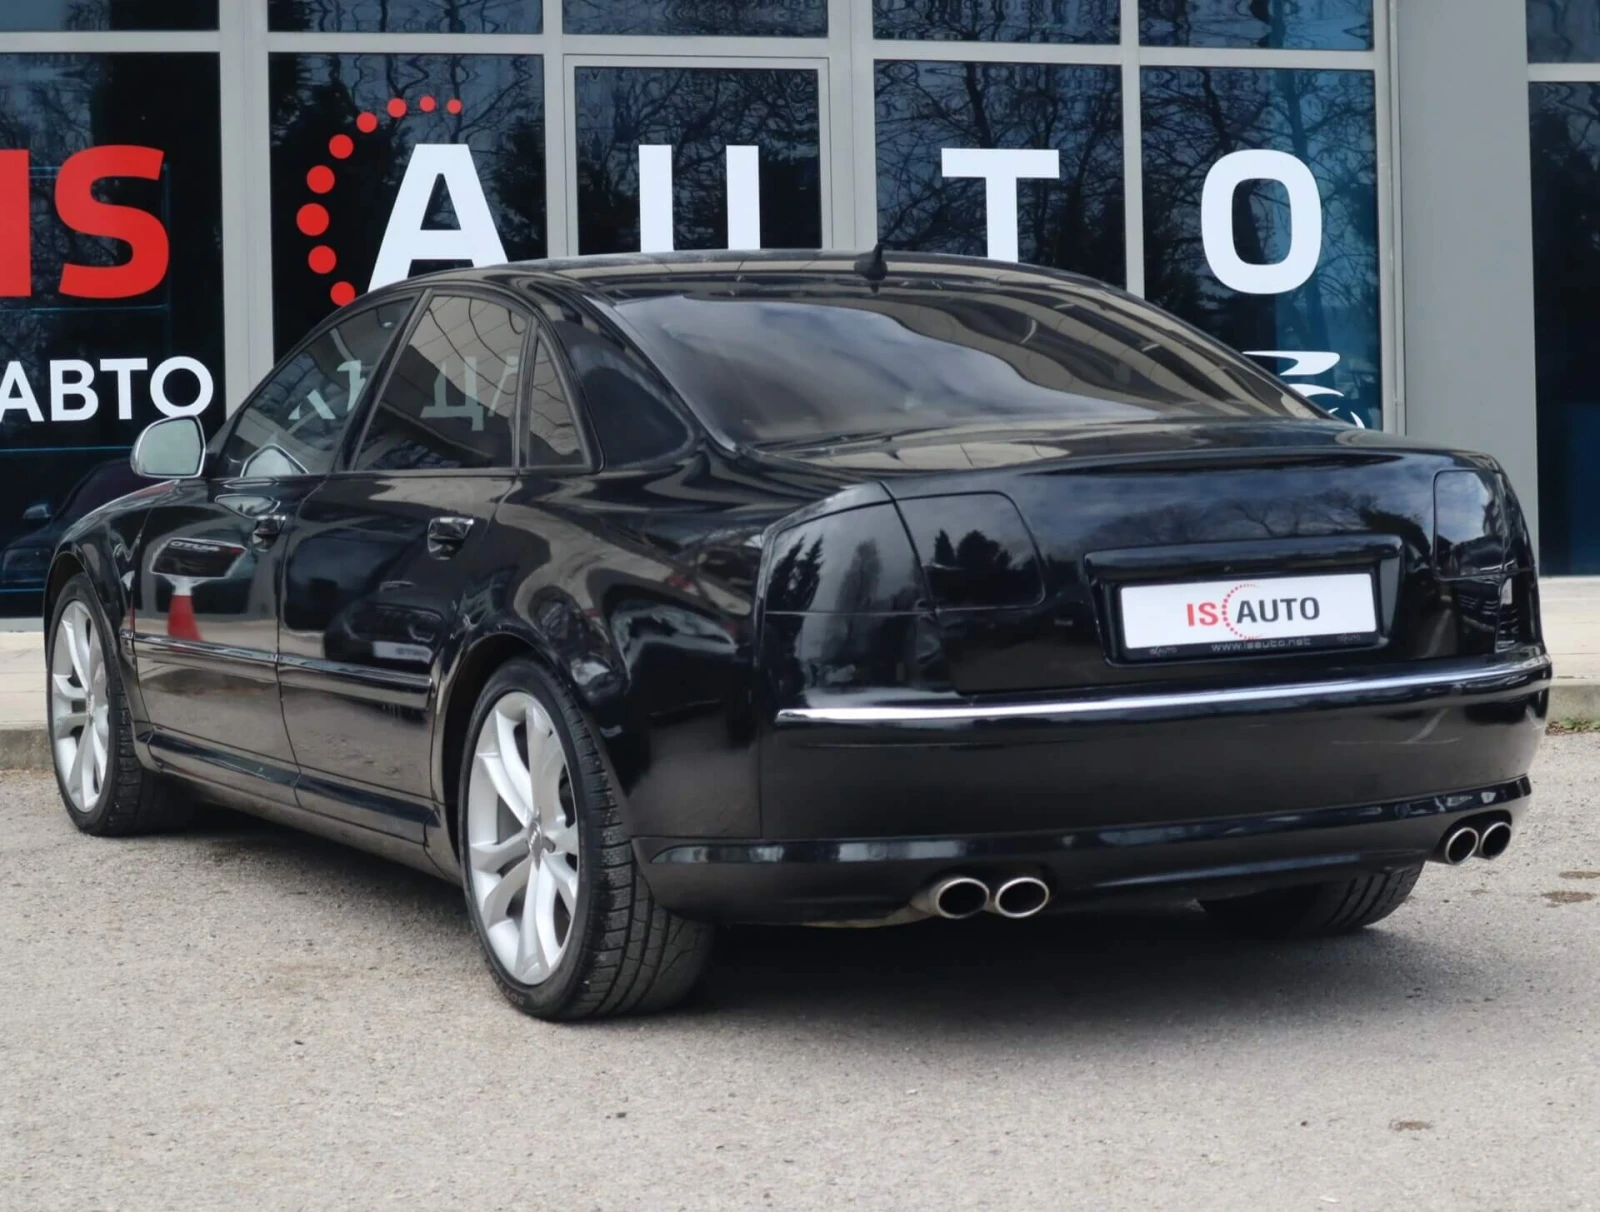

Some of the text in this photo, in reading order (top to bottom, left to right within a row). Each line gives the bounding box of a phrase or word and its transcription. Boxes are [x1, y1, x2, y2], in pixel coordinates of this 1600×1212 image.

[0, 143, 1323, 298] IS AUTO
[0, 356, 214, 423] АВТО
[1186, 597, 1320, 627] IS AUTO
[1211, 637, 1311, 653] www.isauto.net
